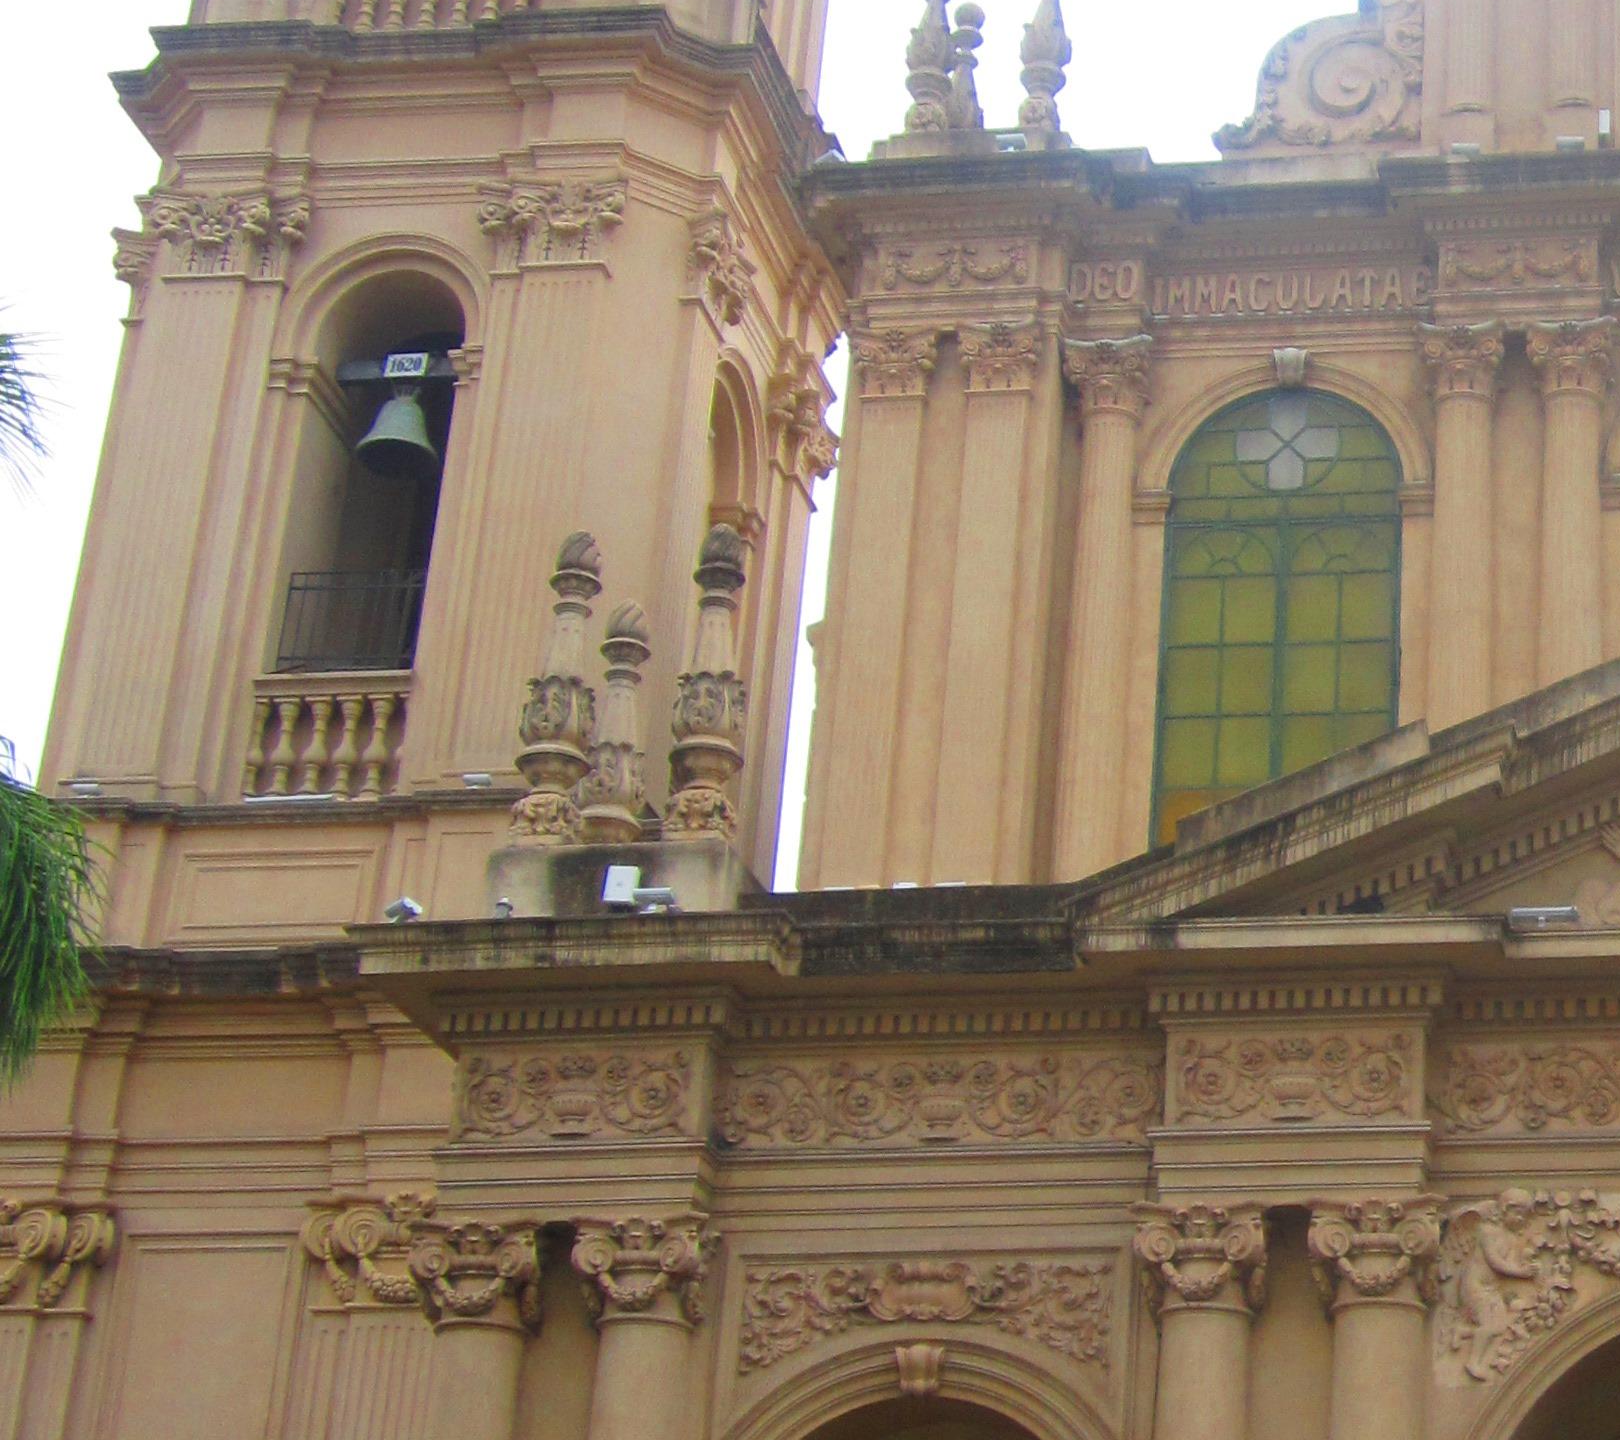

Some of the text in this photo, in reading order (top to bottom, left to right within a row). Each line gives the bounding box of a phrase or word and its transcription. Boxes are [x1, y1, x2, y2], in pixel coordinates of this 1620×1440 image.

[1069, 260, 1137, 302] DEO
[1151, 266, 1433, 315] IMMACULATAE
[388, 357, 423, 373] 1620
